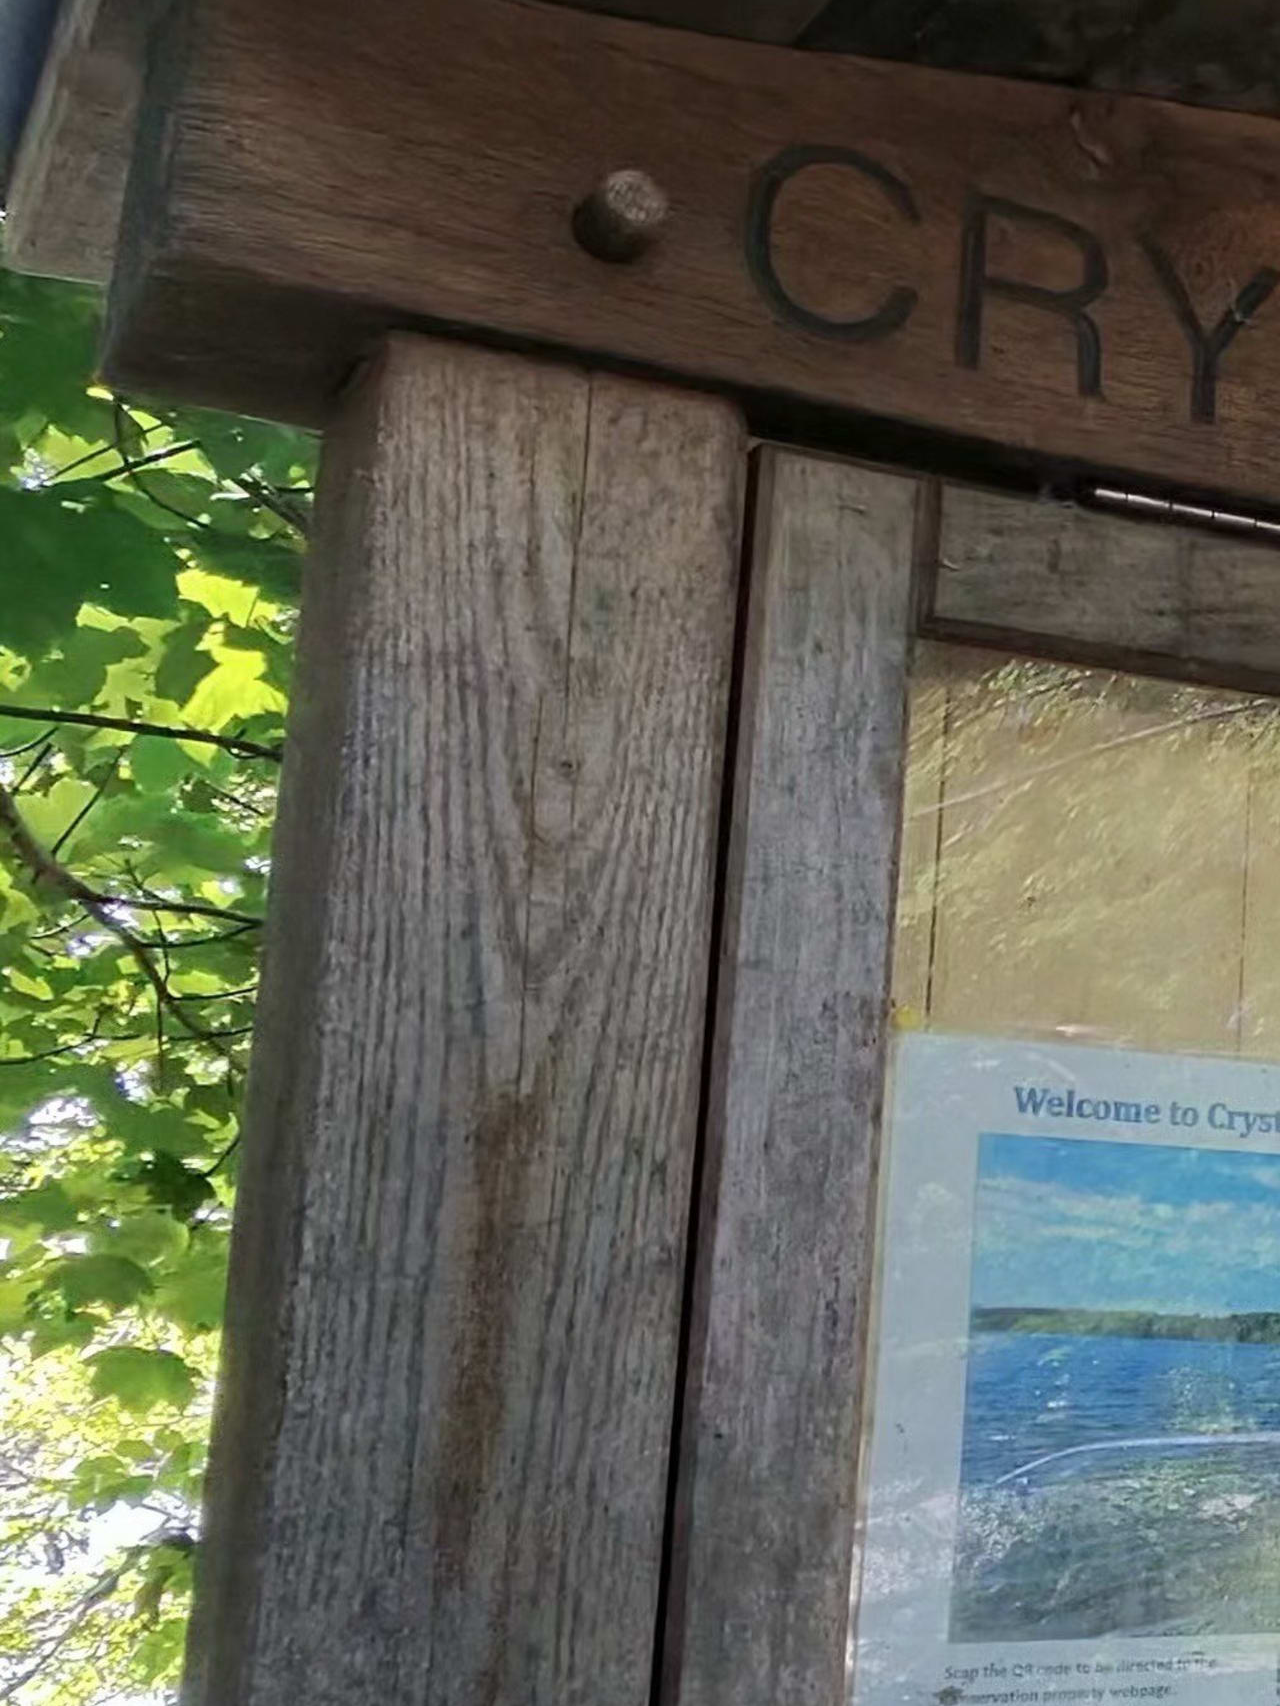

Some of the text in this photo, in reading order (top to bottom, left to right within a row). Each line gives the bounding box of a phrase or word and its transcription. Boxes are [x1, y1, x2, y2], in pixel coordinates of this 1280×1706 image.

[1014, 1086, 1160, 1124] Welcome
[1170, 1101, 1199, 1127] to
[983, 1661, 1006, 1678] the
